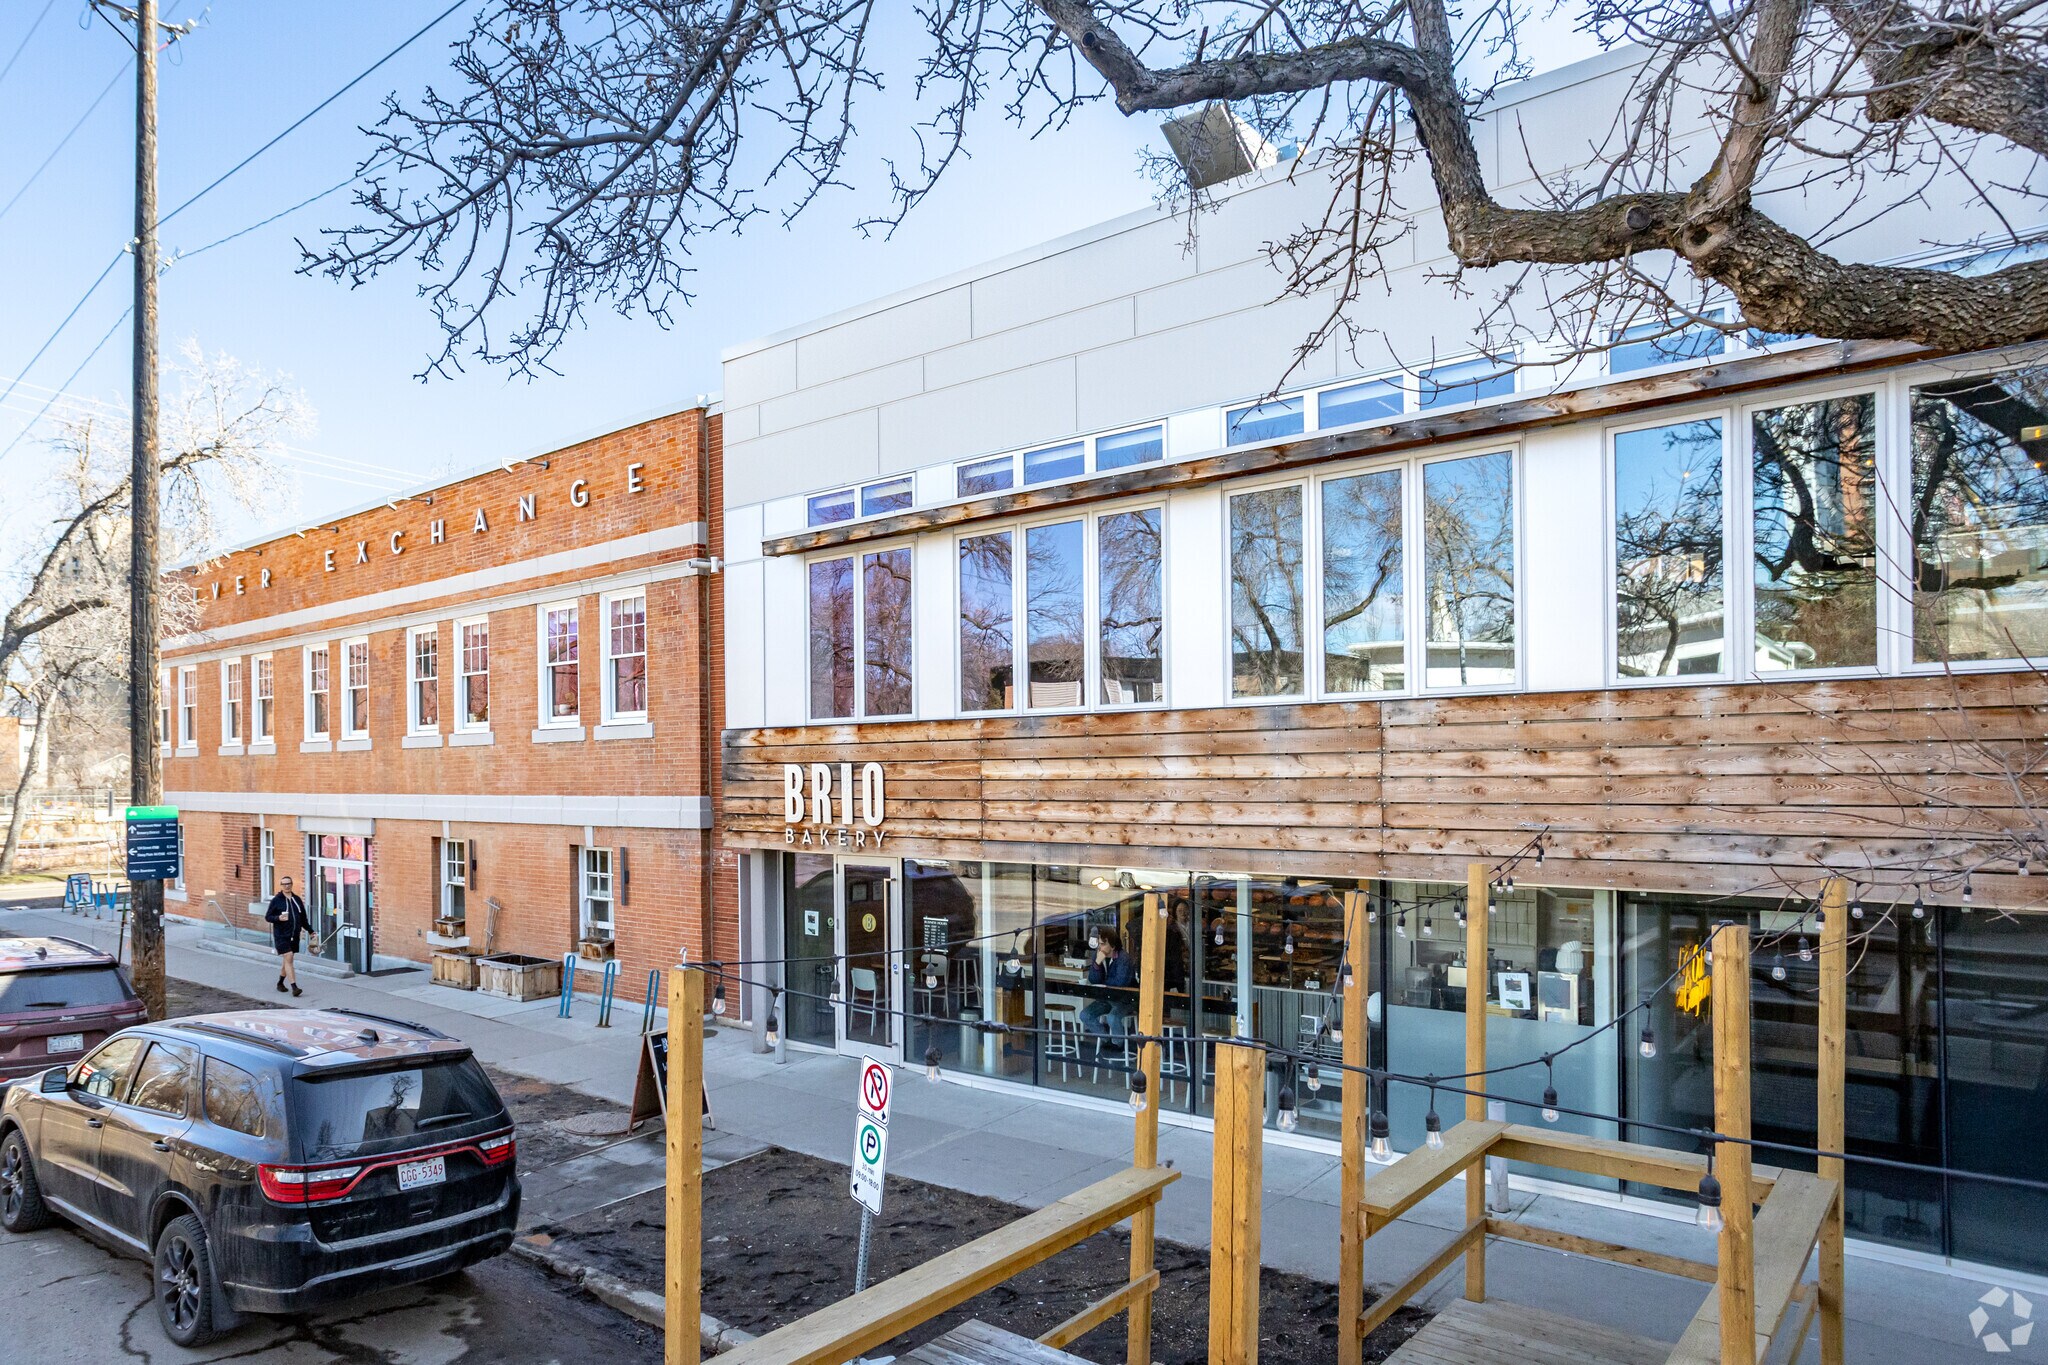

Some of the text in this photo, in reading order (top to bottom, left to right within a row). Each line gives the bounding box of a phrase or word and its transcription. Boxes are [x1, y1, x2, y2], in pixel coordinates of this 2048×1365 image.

[324, 462, 644, 572] EXCHANGE
[784, 762, 884, 827] BRIO
[785, 828, 885, 848] BAKERY
[866, 1132, 876, 1153] P
[401, 1164, 443, 1183] CGG-5349
